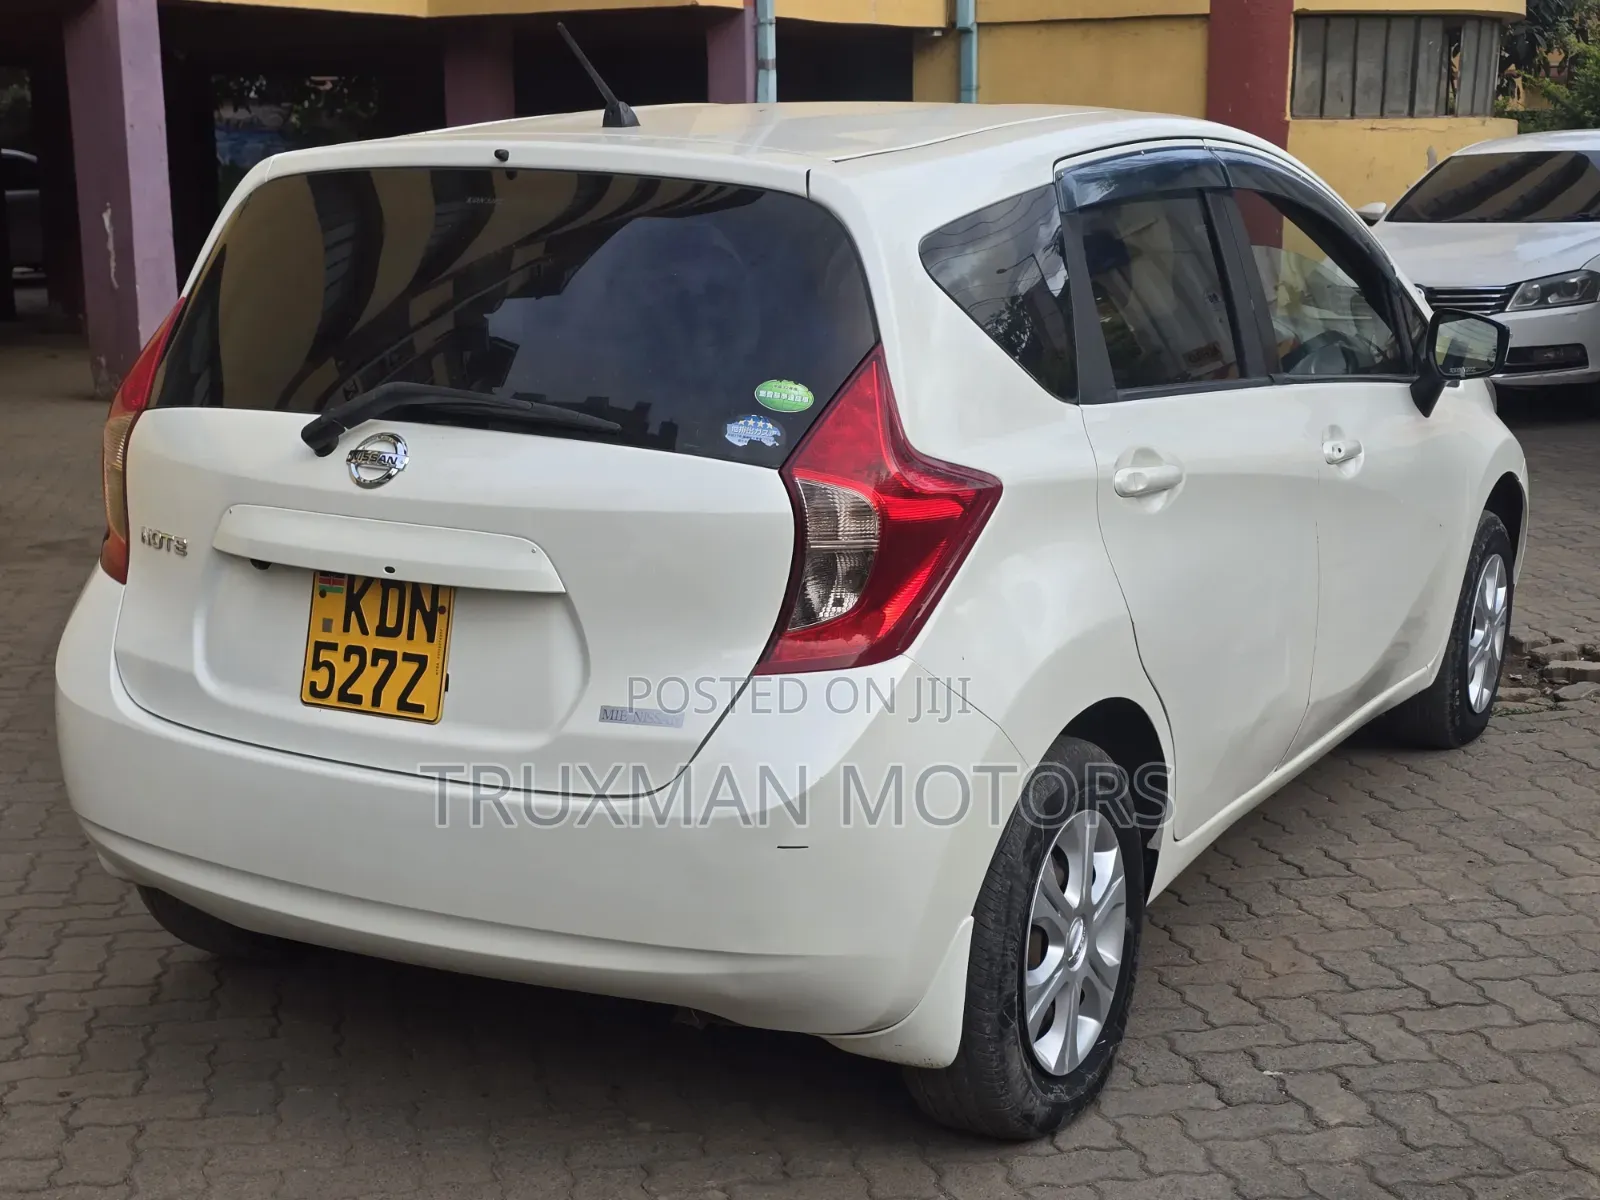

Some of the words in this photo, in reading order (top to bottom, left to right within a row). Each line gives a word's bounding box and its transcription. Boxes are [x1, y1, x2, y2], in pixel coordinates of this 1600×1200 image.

[347, 450, 399, 466] NISSAN
[342, 575, 440, 644] KDN
[308, 640, 429, 714] 527Z
[601, 708, 628, 721] MIE
